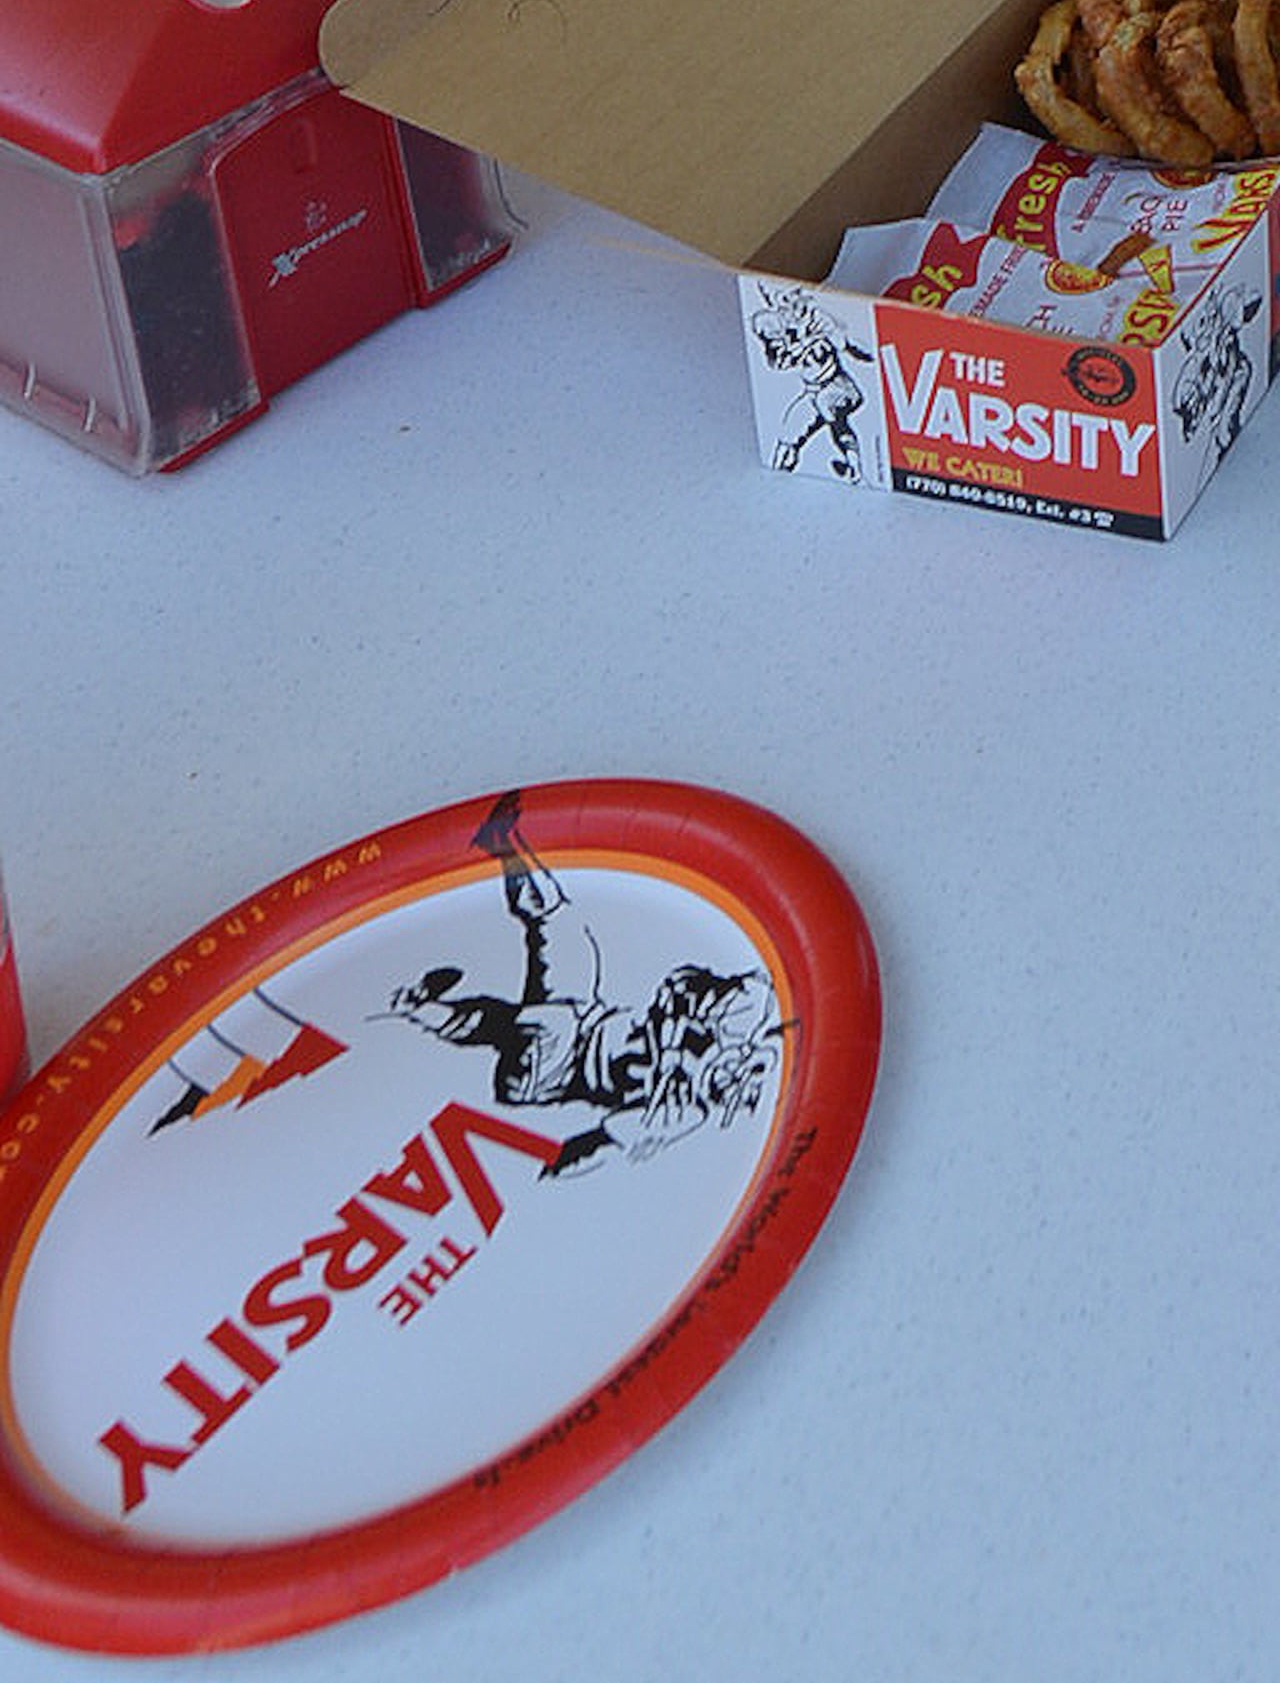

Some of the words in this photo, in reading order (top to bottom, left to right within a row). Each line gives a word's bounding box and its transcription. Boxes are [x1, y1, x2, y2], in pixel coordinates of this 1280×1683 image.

[949, 350, 1006, 387] THE
[879, 342, 1157, 478] VARSITY
[900, 447, 941, 471] WE
[905, 476, 946, 498] (770)
[98, 1101, 565, 1515] VARSITY
[378, 1240, 476, 1328] THE
